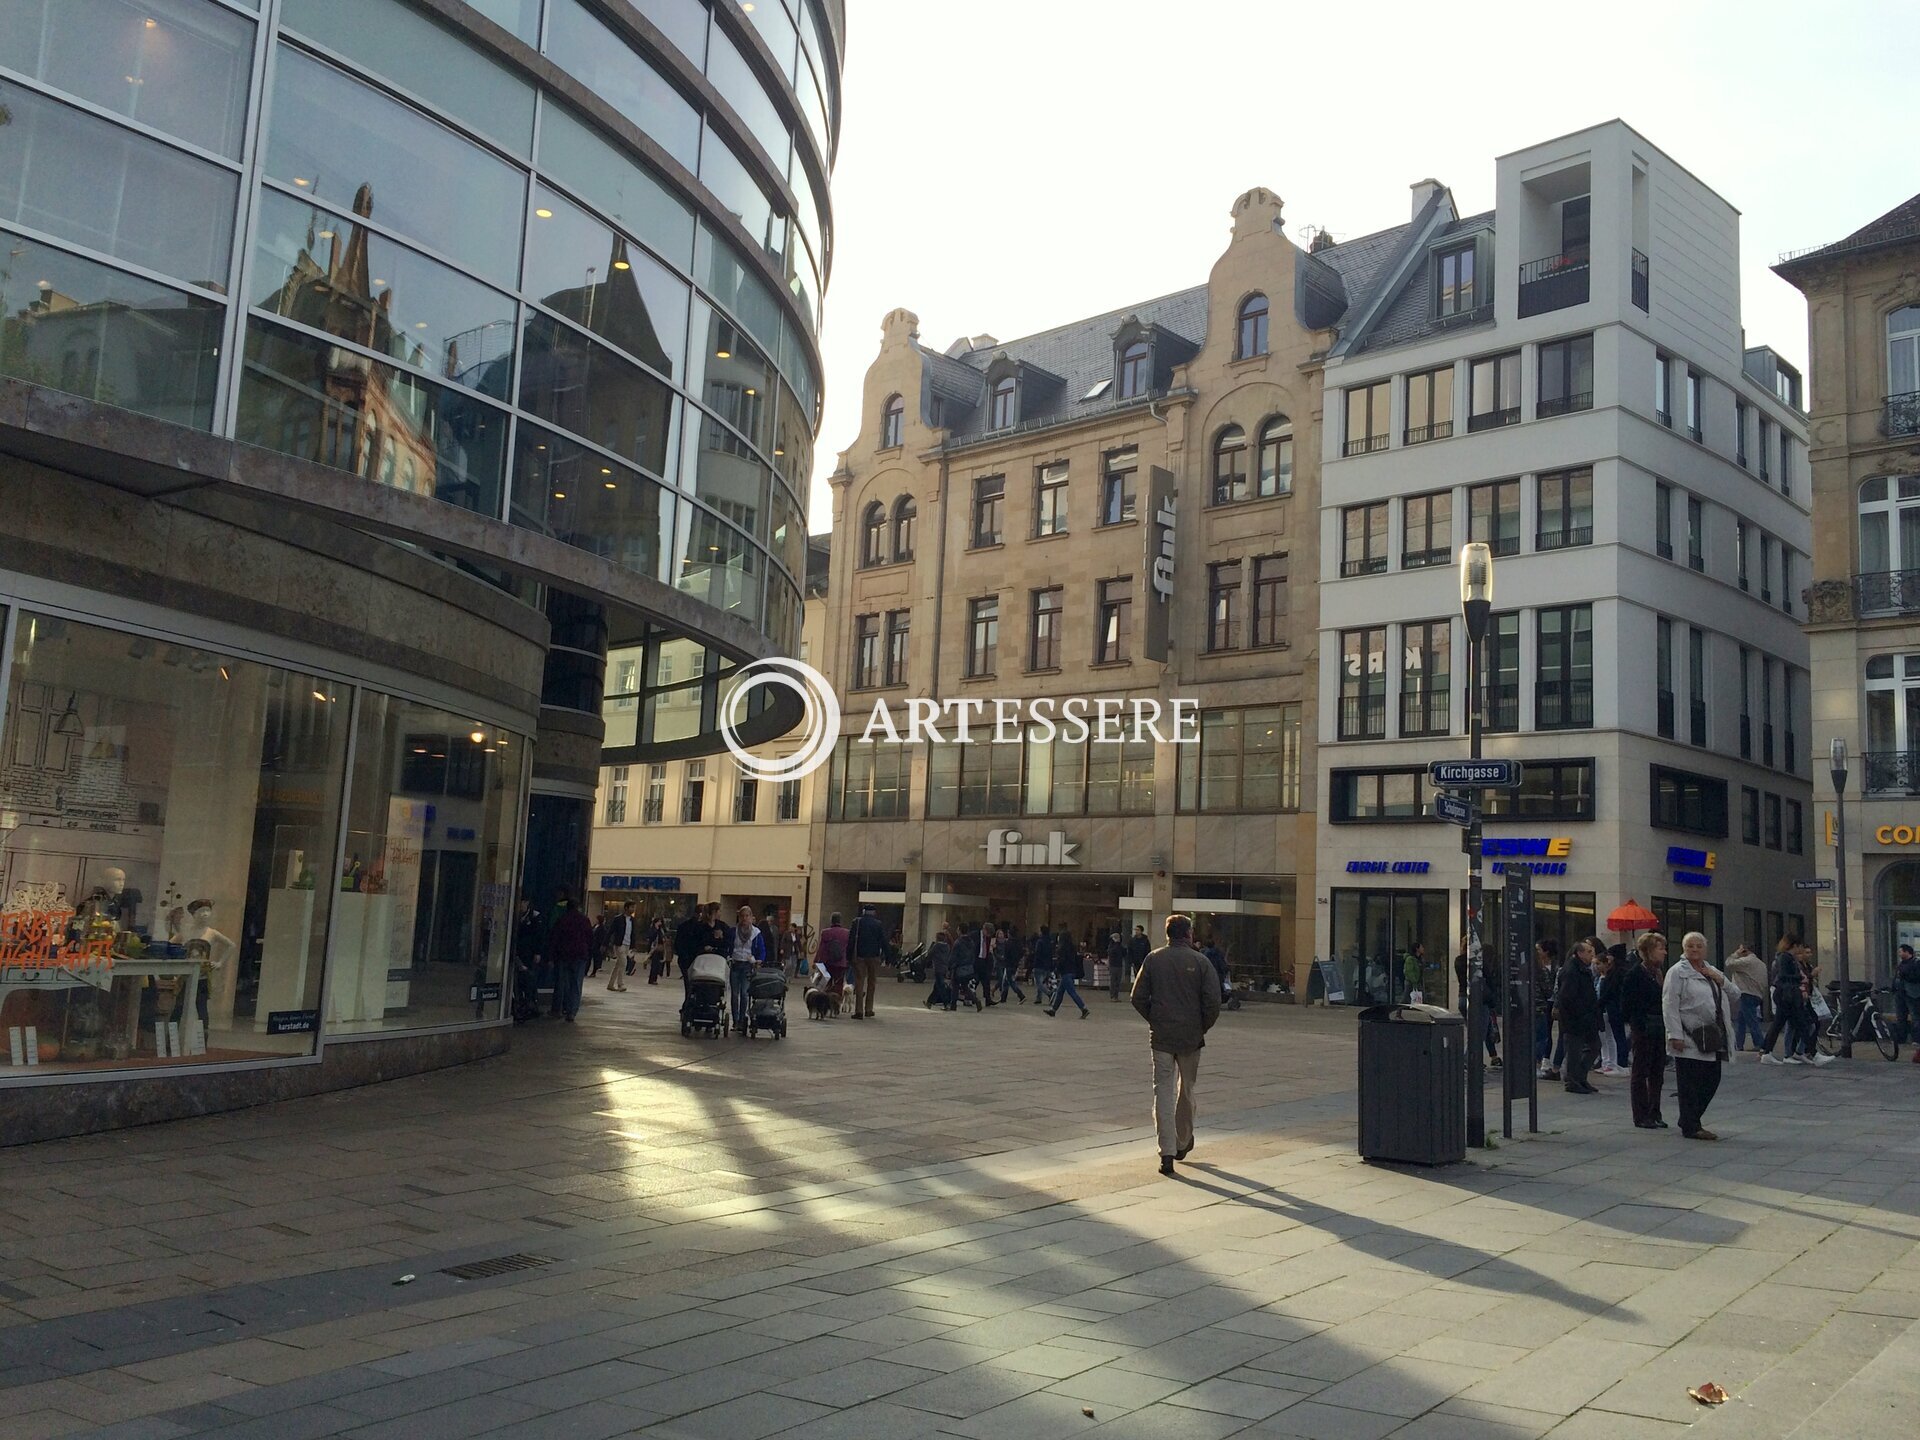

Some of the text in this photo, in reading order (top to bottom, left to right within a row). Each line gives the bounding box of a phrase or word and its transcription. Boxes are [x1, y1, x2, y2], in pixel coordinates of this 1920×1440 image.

[1154, 495, 1176, 603] fink
[1440, 766, 1500, 781] Kirchgasse
[1876, 825, 1920, 845] CO
[979, 829, 1081, 865] fink
[1346, 861, 1430, 873] ENERGIE CENTER
[1318, 897, 1328, 905] 54
